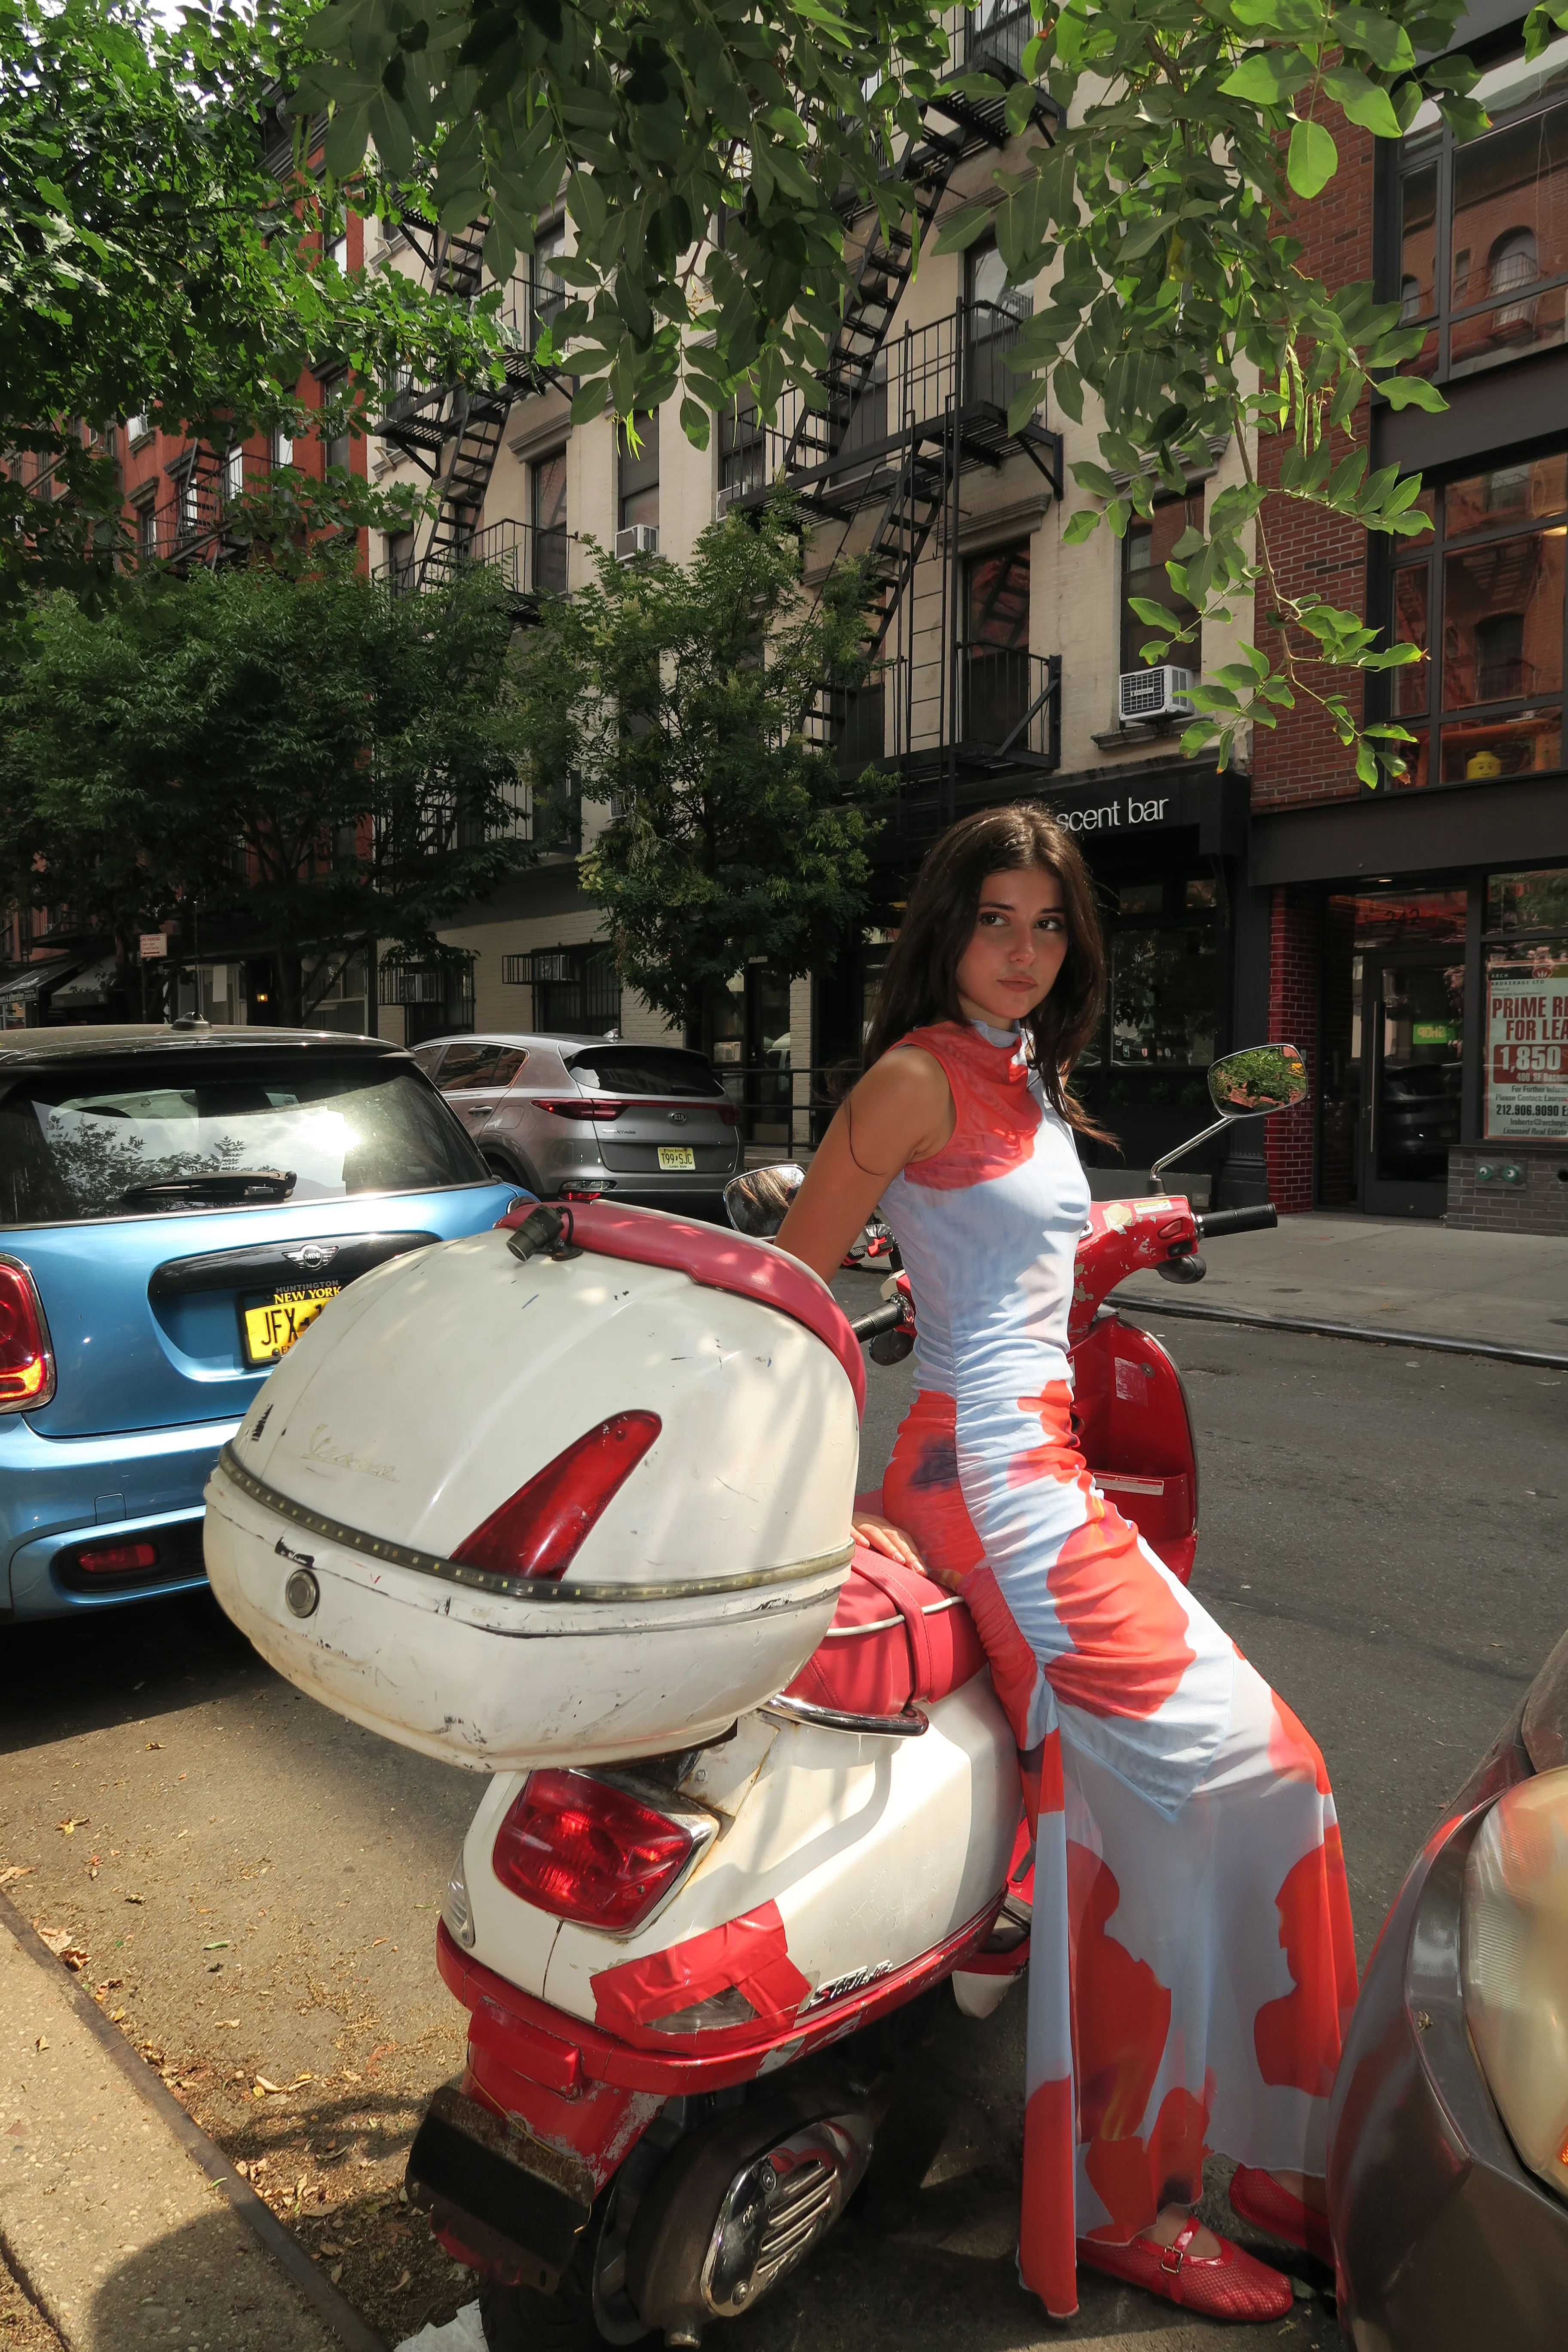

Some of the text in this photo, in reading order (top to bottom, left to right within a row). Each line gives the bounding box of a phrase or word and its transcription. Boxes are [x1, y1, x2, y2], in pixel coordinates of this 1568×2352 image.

[1056, 797, 1169, 833] scent bar
[1385, 908, 1419, 926] 242
[1492, 997, 1547, 1018] PRIME
[1506, 1020, 1536, 1041] FOR
[1500, 1046, 1561, 1073] 1,850
[1516, 1072, 1530, 1082] 400
[1533, 1072, 1541, 1082] SF
[1496, 1104, 1568, 1116] 212.906.9090 E
[273, 1286, 342, 1304] NEW YORK
[276, 1280, 339, 1293] HUNTINGTON
